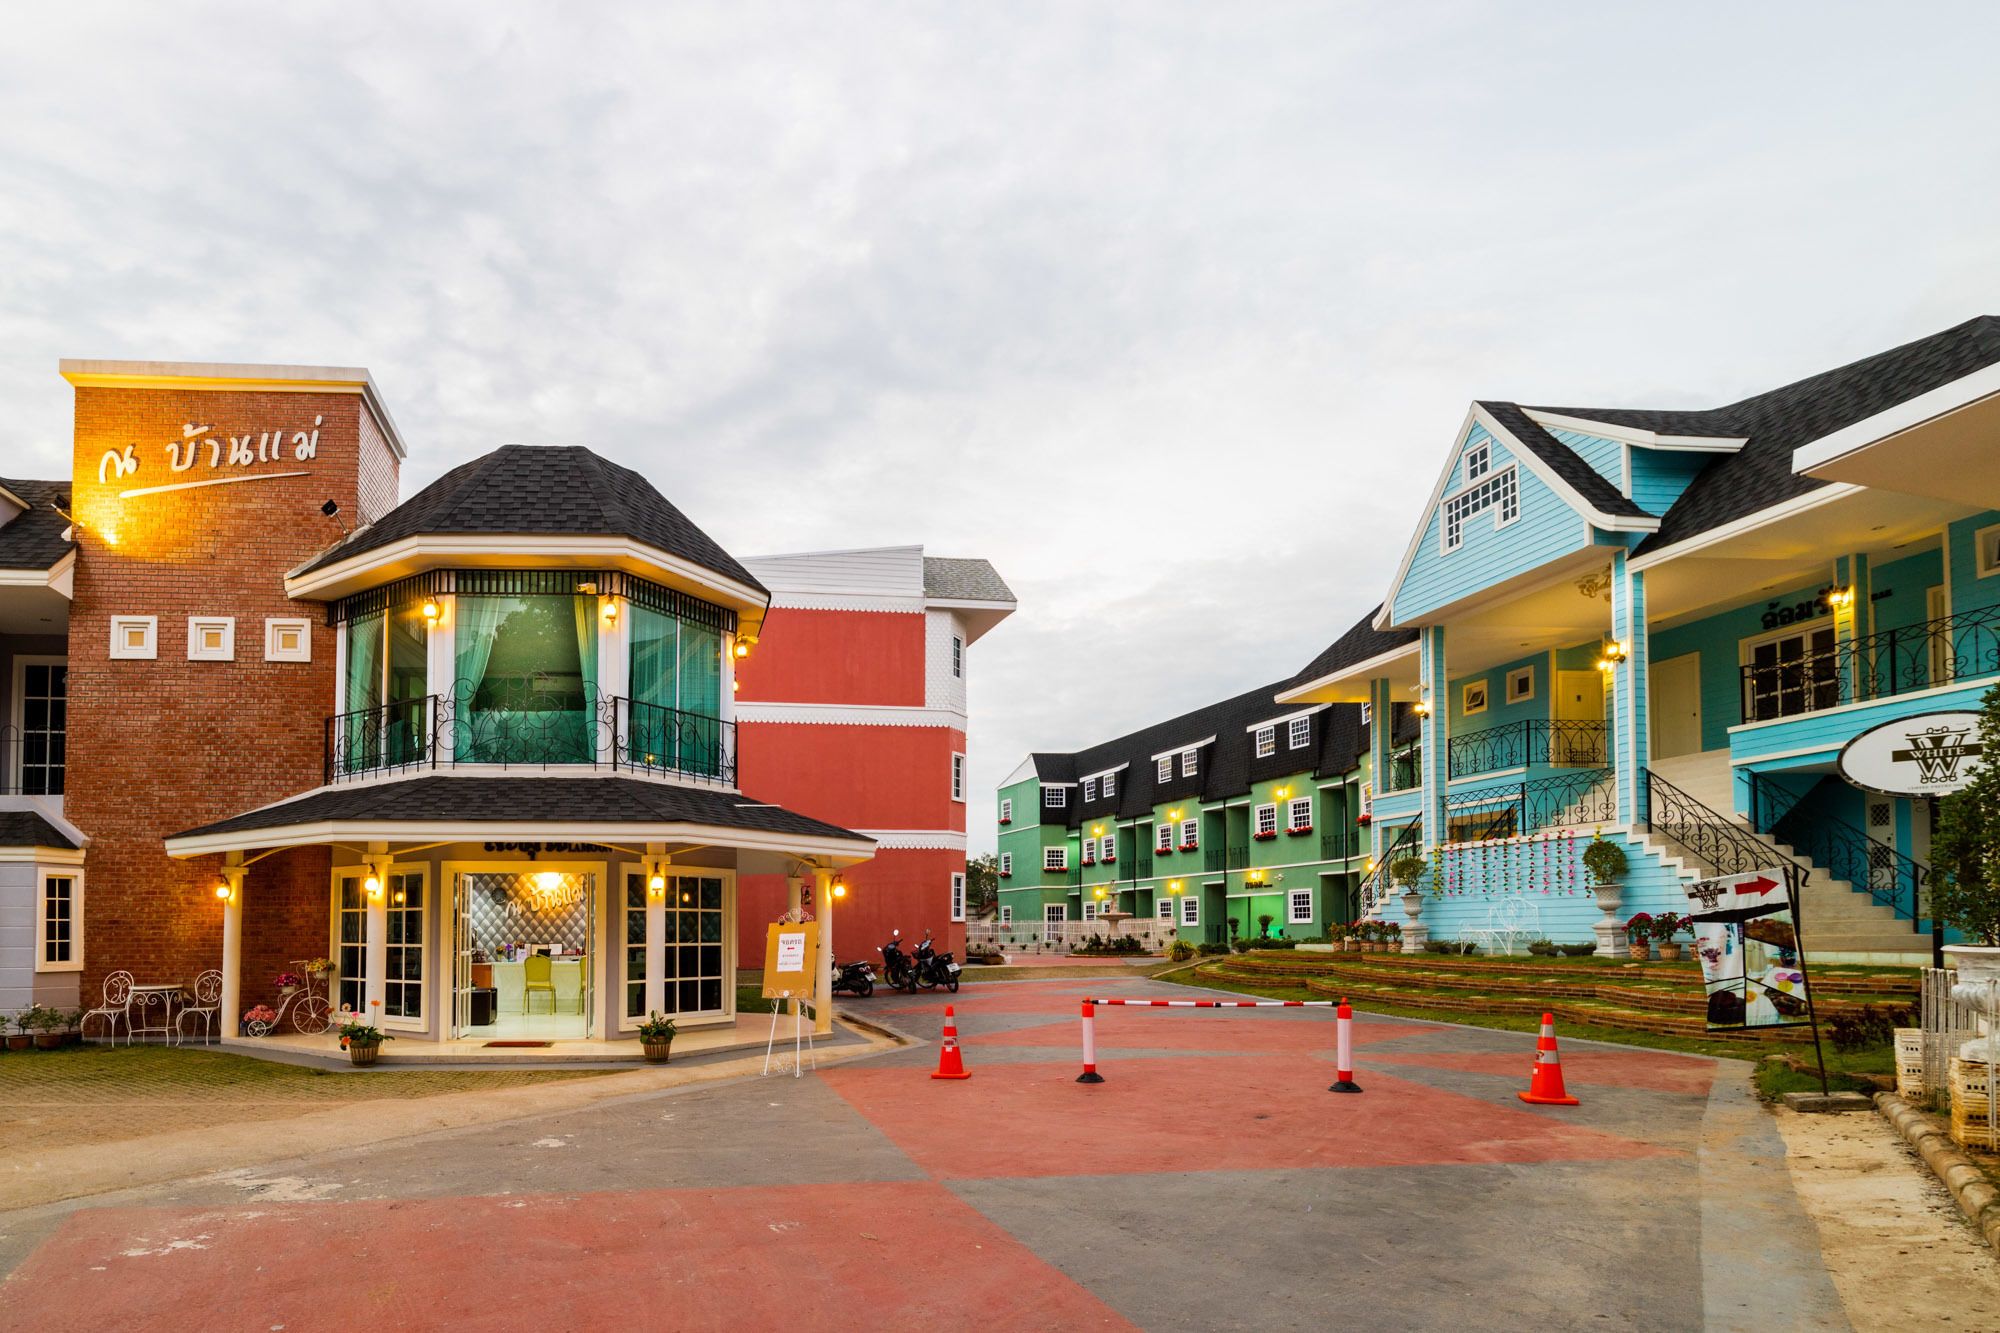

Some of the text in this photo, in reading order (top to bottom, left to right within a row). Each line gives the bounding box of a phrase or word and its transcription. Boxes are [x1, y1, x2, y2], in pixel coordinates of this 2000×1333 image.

[98, 415, 323, 484] ณ บ้านแม่
[1909, 746, 1966, 759] WHITE
